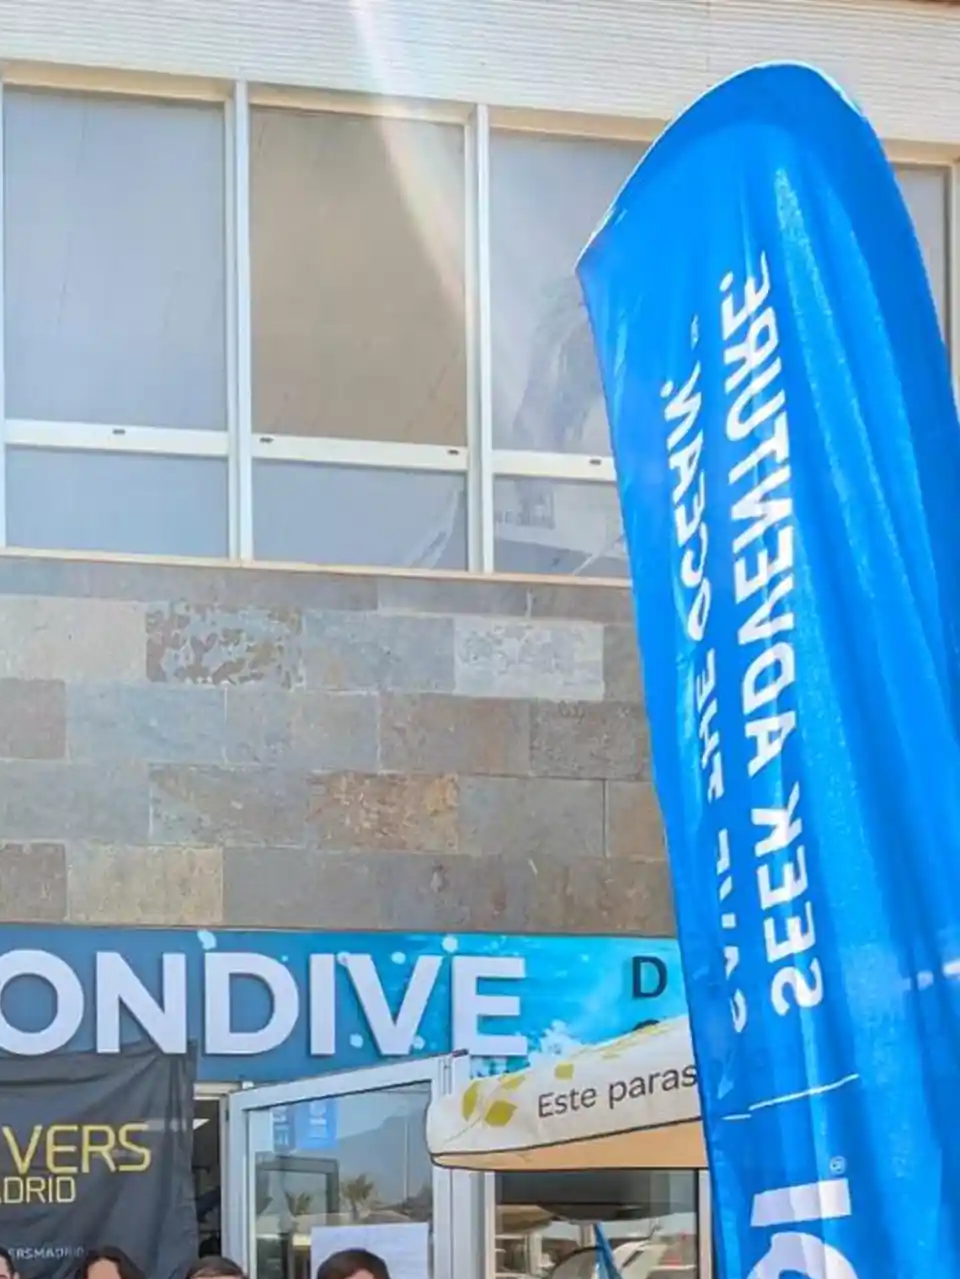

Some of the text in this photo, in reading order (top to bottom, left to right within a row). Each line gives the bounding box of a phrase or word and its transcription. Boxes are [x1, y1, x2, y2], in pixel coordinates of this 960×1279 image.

[632, 955, 668, 998] D
[538, 1064, 699, 1118] Este paras
